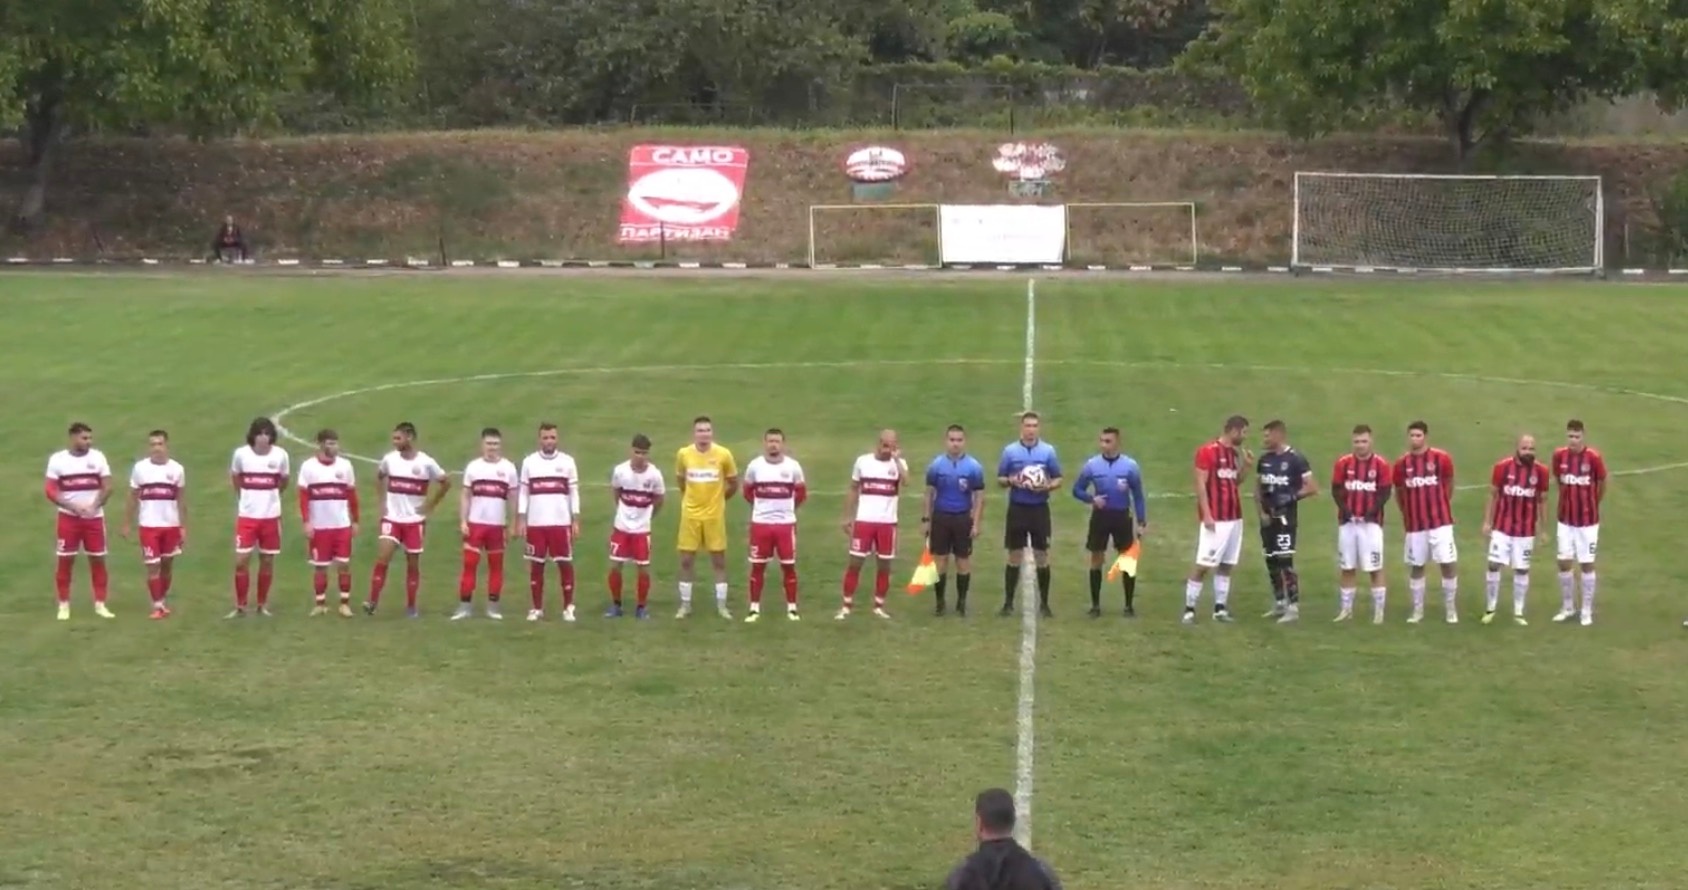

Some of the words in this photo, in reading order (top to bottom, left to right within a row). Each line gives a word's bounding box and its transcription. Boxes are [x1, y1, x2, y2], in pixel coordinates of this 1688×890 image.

[652, 149, 734, 164] САМО
[1345, 480, 1376, 491] efbet
[1405, 475, 1438, 488] efbet
[1277, 534, 1291, 547] 23
